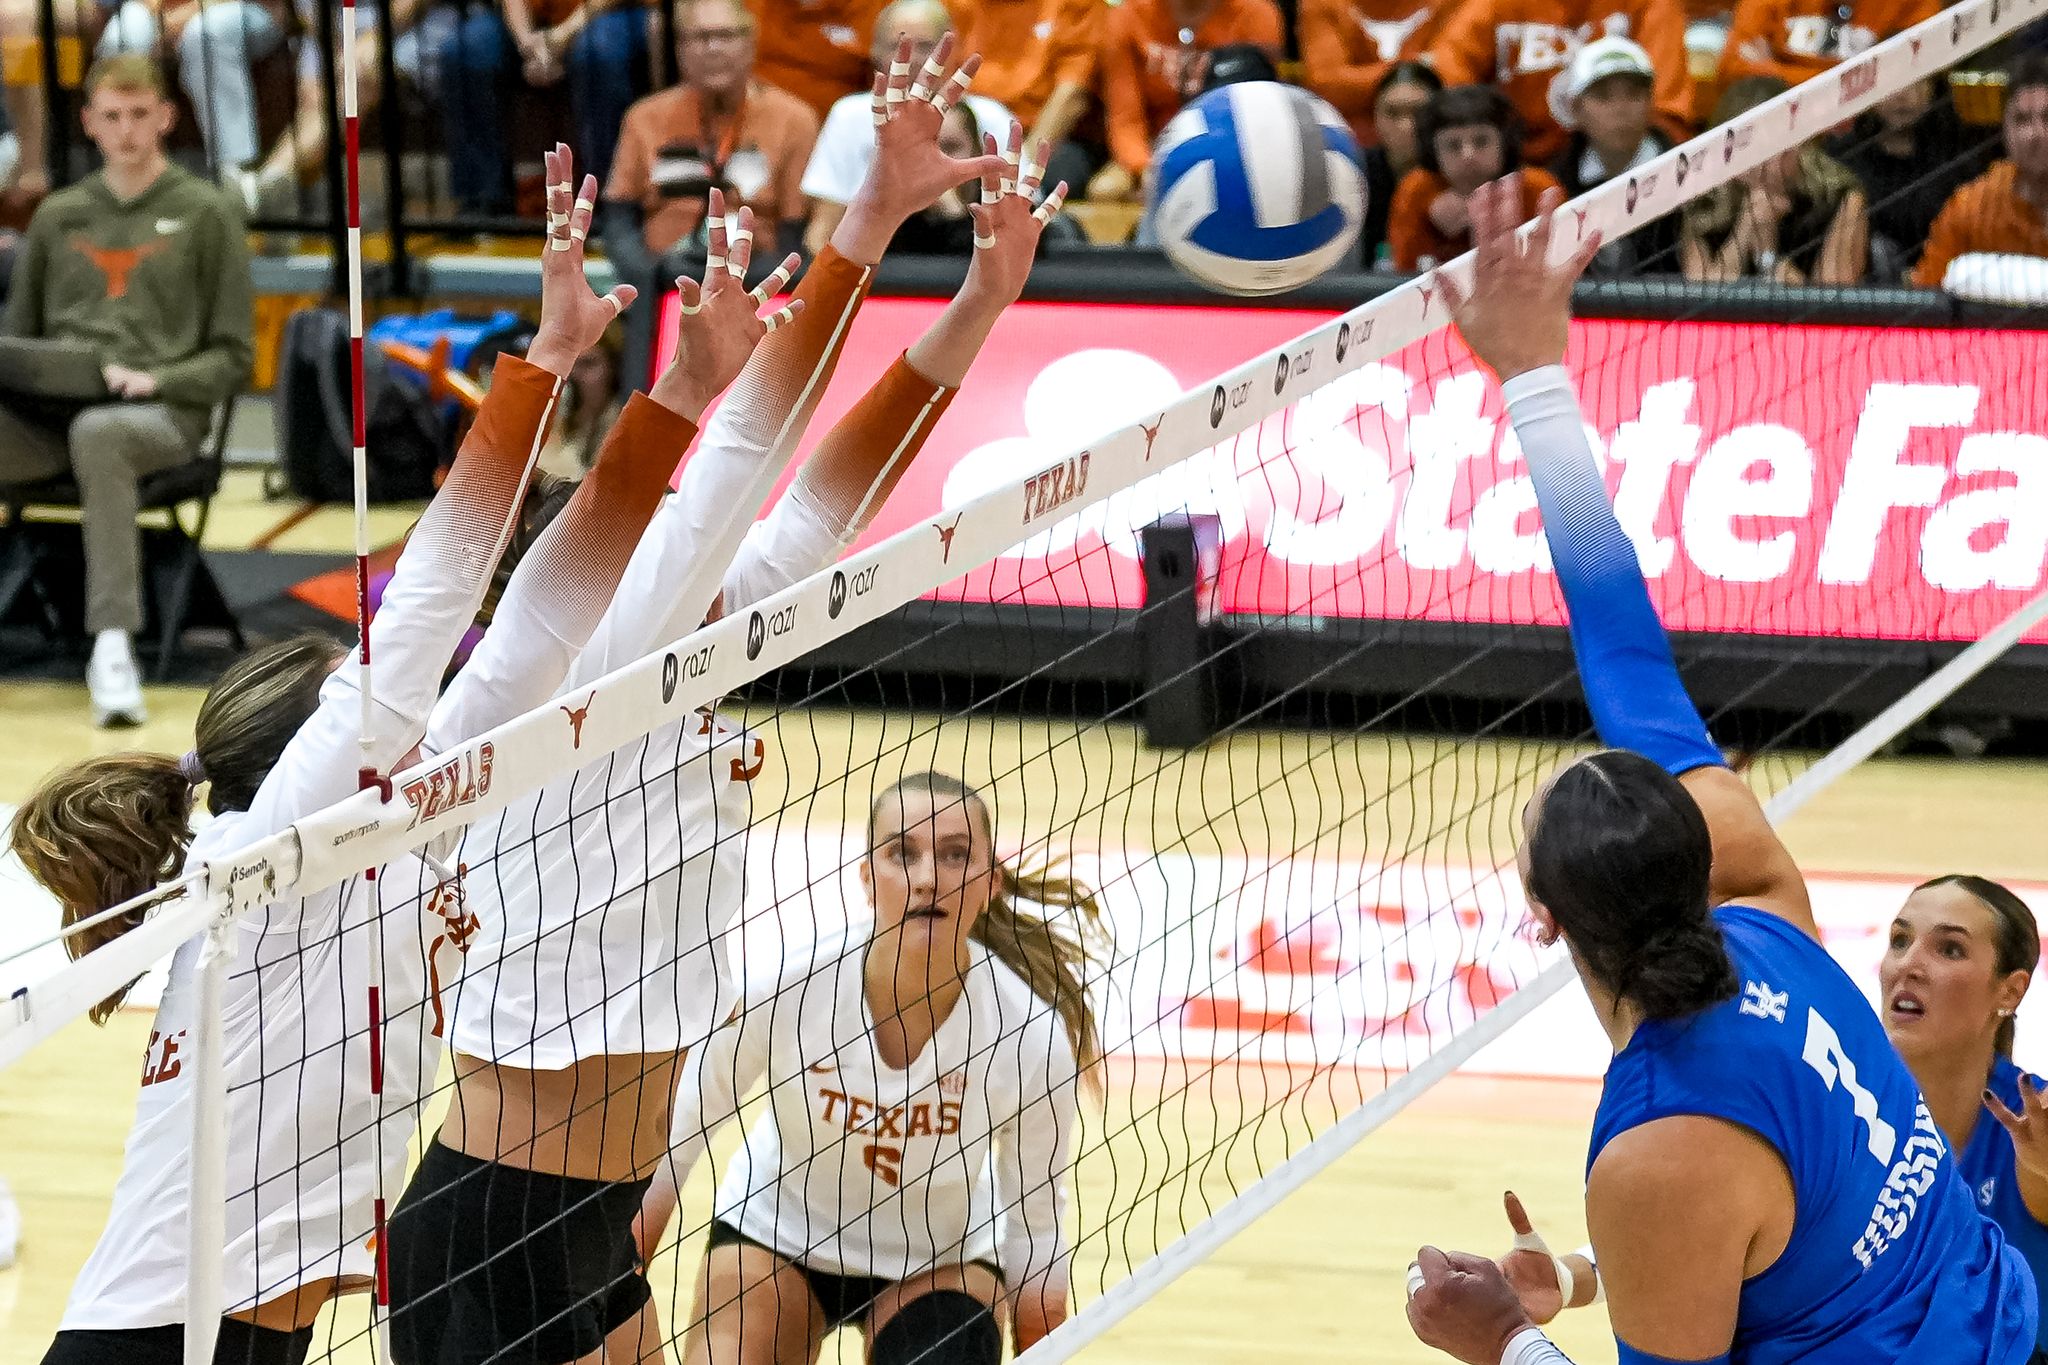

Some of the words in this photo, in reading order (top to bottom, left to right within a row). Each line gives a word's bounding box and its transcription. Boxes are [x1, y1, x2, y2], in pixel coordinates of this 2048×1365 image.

[1022, 450, 1091, 526] TEXAS
[849, 563, 880, 600] razr
[766, 603, 799, 642] razr
[681, 644, 716, 684] razr
[401, 741, 495, 832] TEXAS
[818, 1087, 961, 1139] TEXAS
